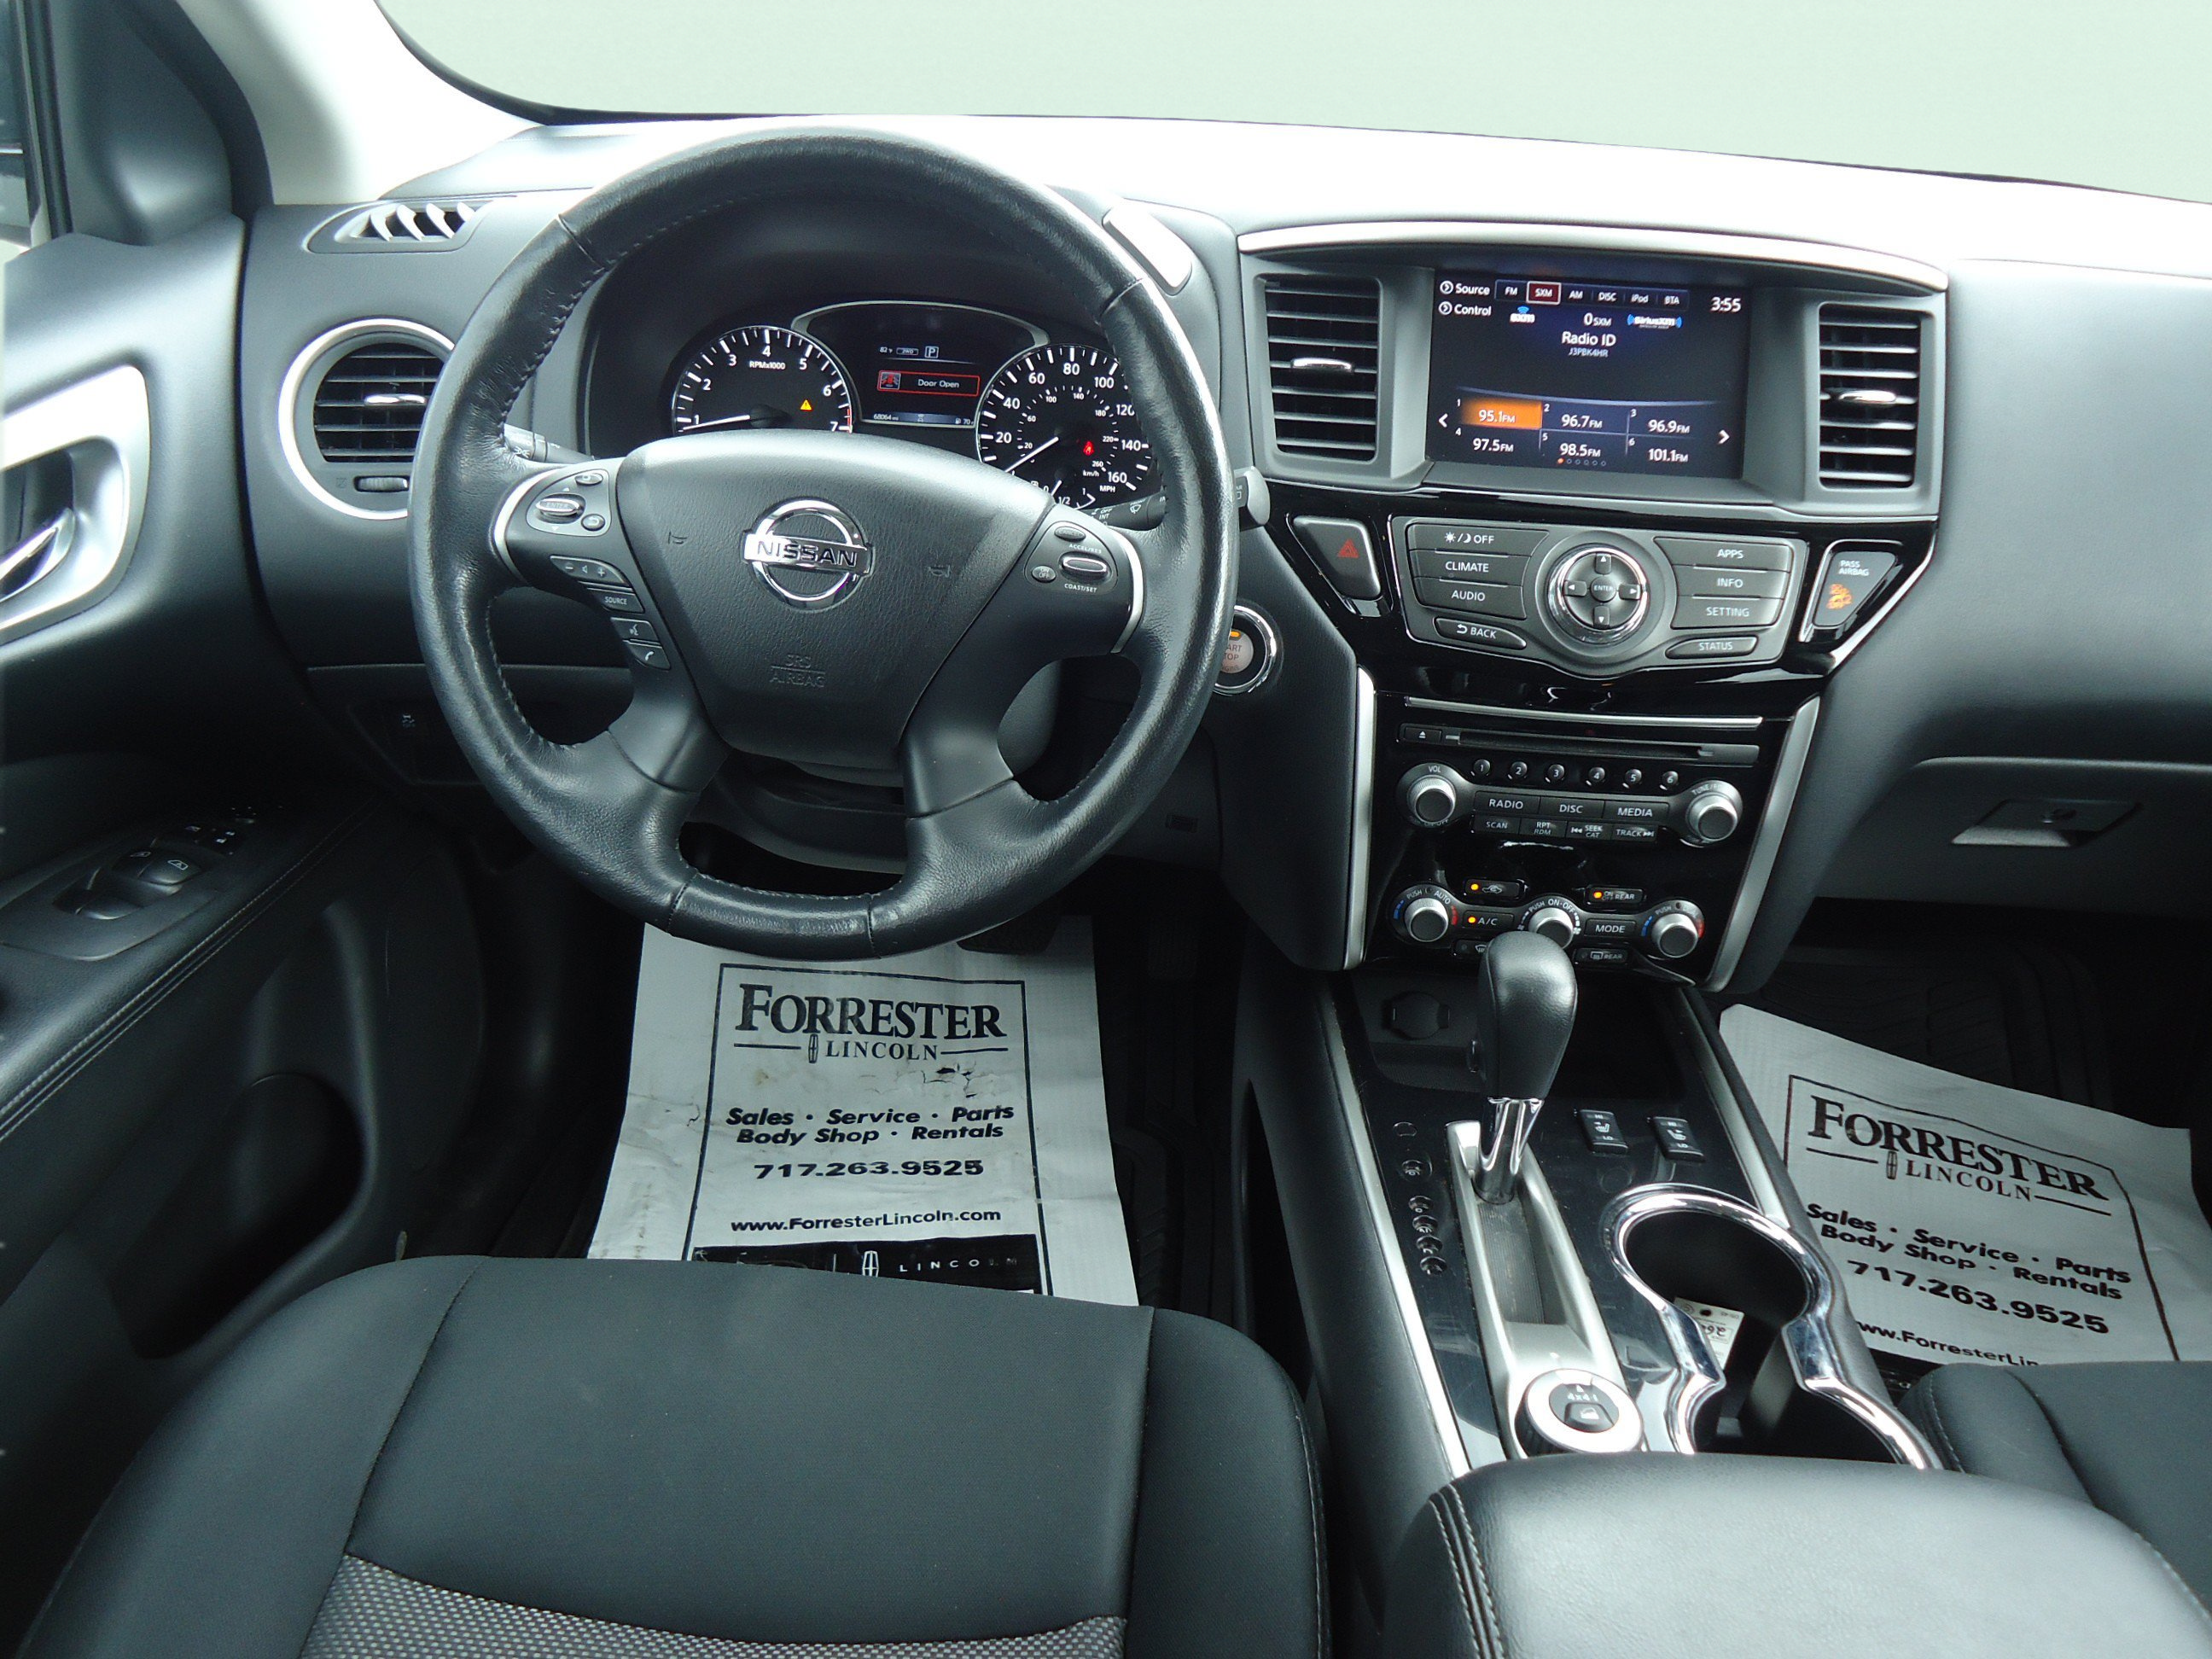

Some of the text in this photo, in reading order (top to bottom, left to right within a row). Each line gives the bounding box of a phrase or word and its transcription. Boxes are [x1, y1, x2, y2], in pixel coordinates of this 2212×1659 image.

[1455, 282, 1491, 296] Source
[1505, 286, 1518, 295] FM
[1534, 288, 1553, 298] SXM
[1569, 290, 1583, 300] AM
[1598, 292, 1617, 302] DISC
[1631, 294, 1649, 304] iPod
[1710, 296, 1742, 312] 3:55
[1453, 304, 1493, 317] Control
[1562, 331, 1617, 347] Radio ID
[762, 345, 771, 358] 4
[728, 354, 736, 366] 3
[799, 358, 807, 370] 5
[1062, 363, 1080, 375] 80
[702, 378, 712, 391] 2
[917, 378, 960, 389] Door Open
[1028, 373, 1045, 385] 60
[1094, 376, 1115, 389] 100
[823, 385, 832, 397] 6
[1003, 398, 1021, 410] 40
[1115, 405, 1135, 416] 120
[1456, 398, 1516, 423] 1 95.1FM
[1544, 403, 1603, 428] 2 96.7FM
[694, 414, 700, 425] 1
[1630, 408, 1691, 434] 3 96.9FM
[830, 421, 838, 432] 7
[995, 432, 1012, 444] 20
[1455, 427, 1514, 452] 4 97.5FM
[1121, 439, 1142, 451] 140
[1542, 433, 1601, 457] 5 98.5FM
[1628, 437, 1689, 463] 6 101.1FM
[1083, 469, 1100, 478] km/h
[1108, 471, 1127, 484] 160
[1099, 485, 1116, 493] MPH
[1057, 496, 1070, 505] 1/2
[1473, 534, 1495, 544] OFF
[757, 540, 858, 568] NISSAN
[1716, 548, 1744, 560] APPS
[1445, 561, 1489, 573] CLIMATE
[1839, 559, 1860, 568] PASS
[1838, 568, 1870, 577] AIRBAG
[1064, 583, 1097, 593] COAST/SET
[1593, 584, 1614, 592] ENTER
[1716, 577, 1743, 588] INFO
[604, 596, 628, 606] SOURCE
[1451, 590, 1487, 602] AUDIO
[1706, 606, 1750, 618] SETTING
[1470, 626, 1497, 639] BACK
[1698, 641, 1734, 651] STATUS
[1428, 765, 1441, 774] VOL
[1516, 767, 1522, 776] 2
[1553, 769, 1560, 777] 3
[1593, 771, 1600, 780] 4
[1630, 774, 1636, 783] 5
[1667, 776, 1674, 784] 6
[1488, 798, 1524, 810] RADIO
[1559, 804, 1584, 814] DISC
[1617, 807, 1653, 818] MEDIA
[1486, 821, 1508, 830] SCAN
[1615, 829, 1643, 838] TRACK
[1406, 888, 1451, 905] PUSH AUTO
[1615, 892, 1635, 900] REAR
[1528, 900, 1545, 912] PUSH
[1654, 905, 1673, 916] PUSH
[1477, 917, 1499, 926] A/C
[1595, 923, 1626, 934] MODE
[734, 982, 1008, 1041] FORRESTER
[824, 1039, 939, 1061] LINCOLN
[725, 1104, 1015, 1126] Sales Service Parts
[736, 1123, 1004, 1147] Body Shop Rentals
[1807, 1095, 2110, 1202] FORRESTER
[753, 1158, 985, 1180] 717.263.9525
[1905, 1158, 2033, 1202] LINCOLN
[731, 1208, 1002, 1232] www.ForresterLincoln.com
[1806, 1203, 2132, 1284] Sales Service Parts
[1820, 1224, 2123, 1301] Body Shop Rentals
[1847, 1260, 2110, 1335] 717.263.9525
